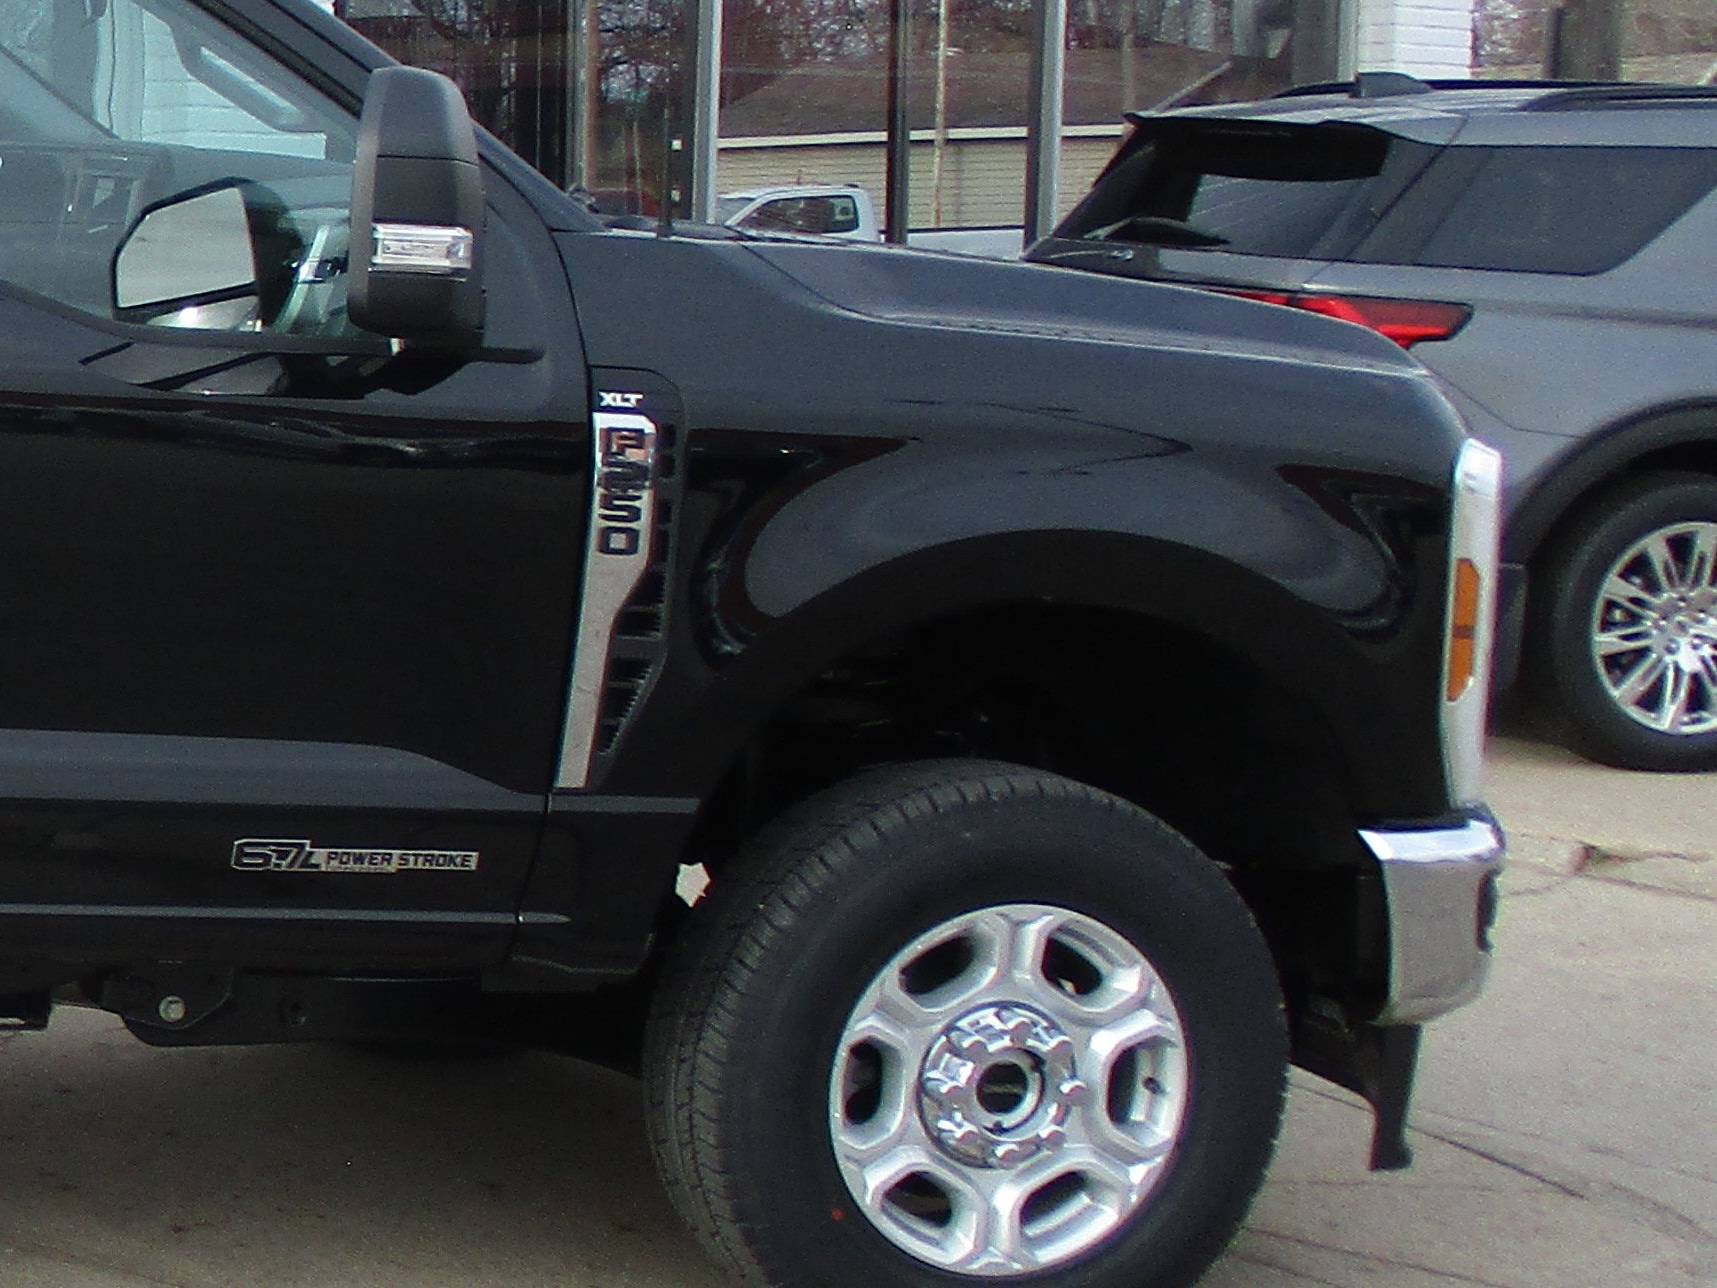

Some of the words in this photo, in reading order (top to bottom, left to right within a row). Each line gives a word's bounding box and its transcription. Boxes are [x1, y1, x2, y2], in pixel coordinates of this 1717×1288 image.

[598, 391, 644, 408] XLT
[325, 850, 393, 868] POWER
[398, 852, 473, 869] STROKE
